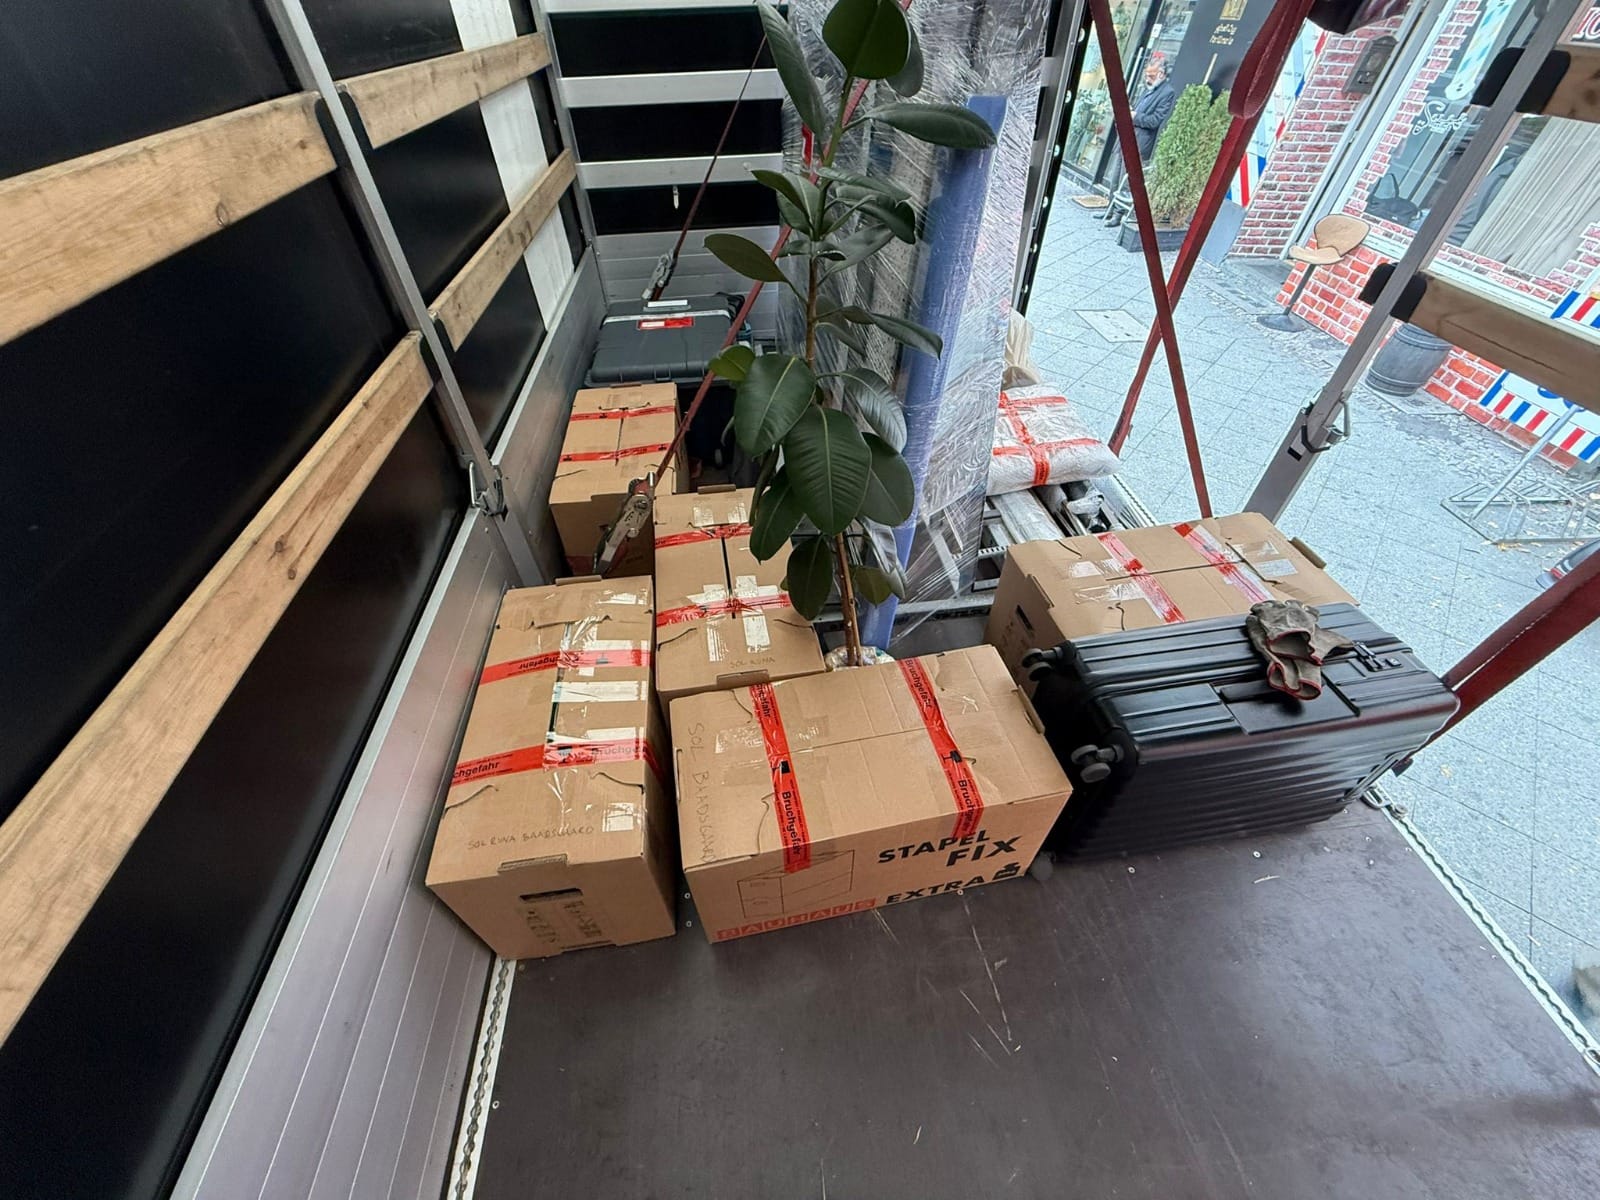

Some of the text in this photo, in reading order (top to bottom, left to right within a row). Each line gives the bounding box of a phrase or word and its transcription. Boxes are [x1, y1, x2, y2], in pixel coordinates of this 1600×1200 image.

[904, 658, 933, 709] Bruchgefahr
[688, 722, 705, 762] SOL
[453, 760, 500, 779] chgefahr
[781, 790, 801, 856] Bruchgefahr
[467, 840, 487, 850] SOL
[878, 829, 991, 864] STAPEL
[946, 835, 1022, 867] FIX
[886, 875, 985, 905] EXTRA
[716, 898, 876, 940] BAUHAUS
